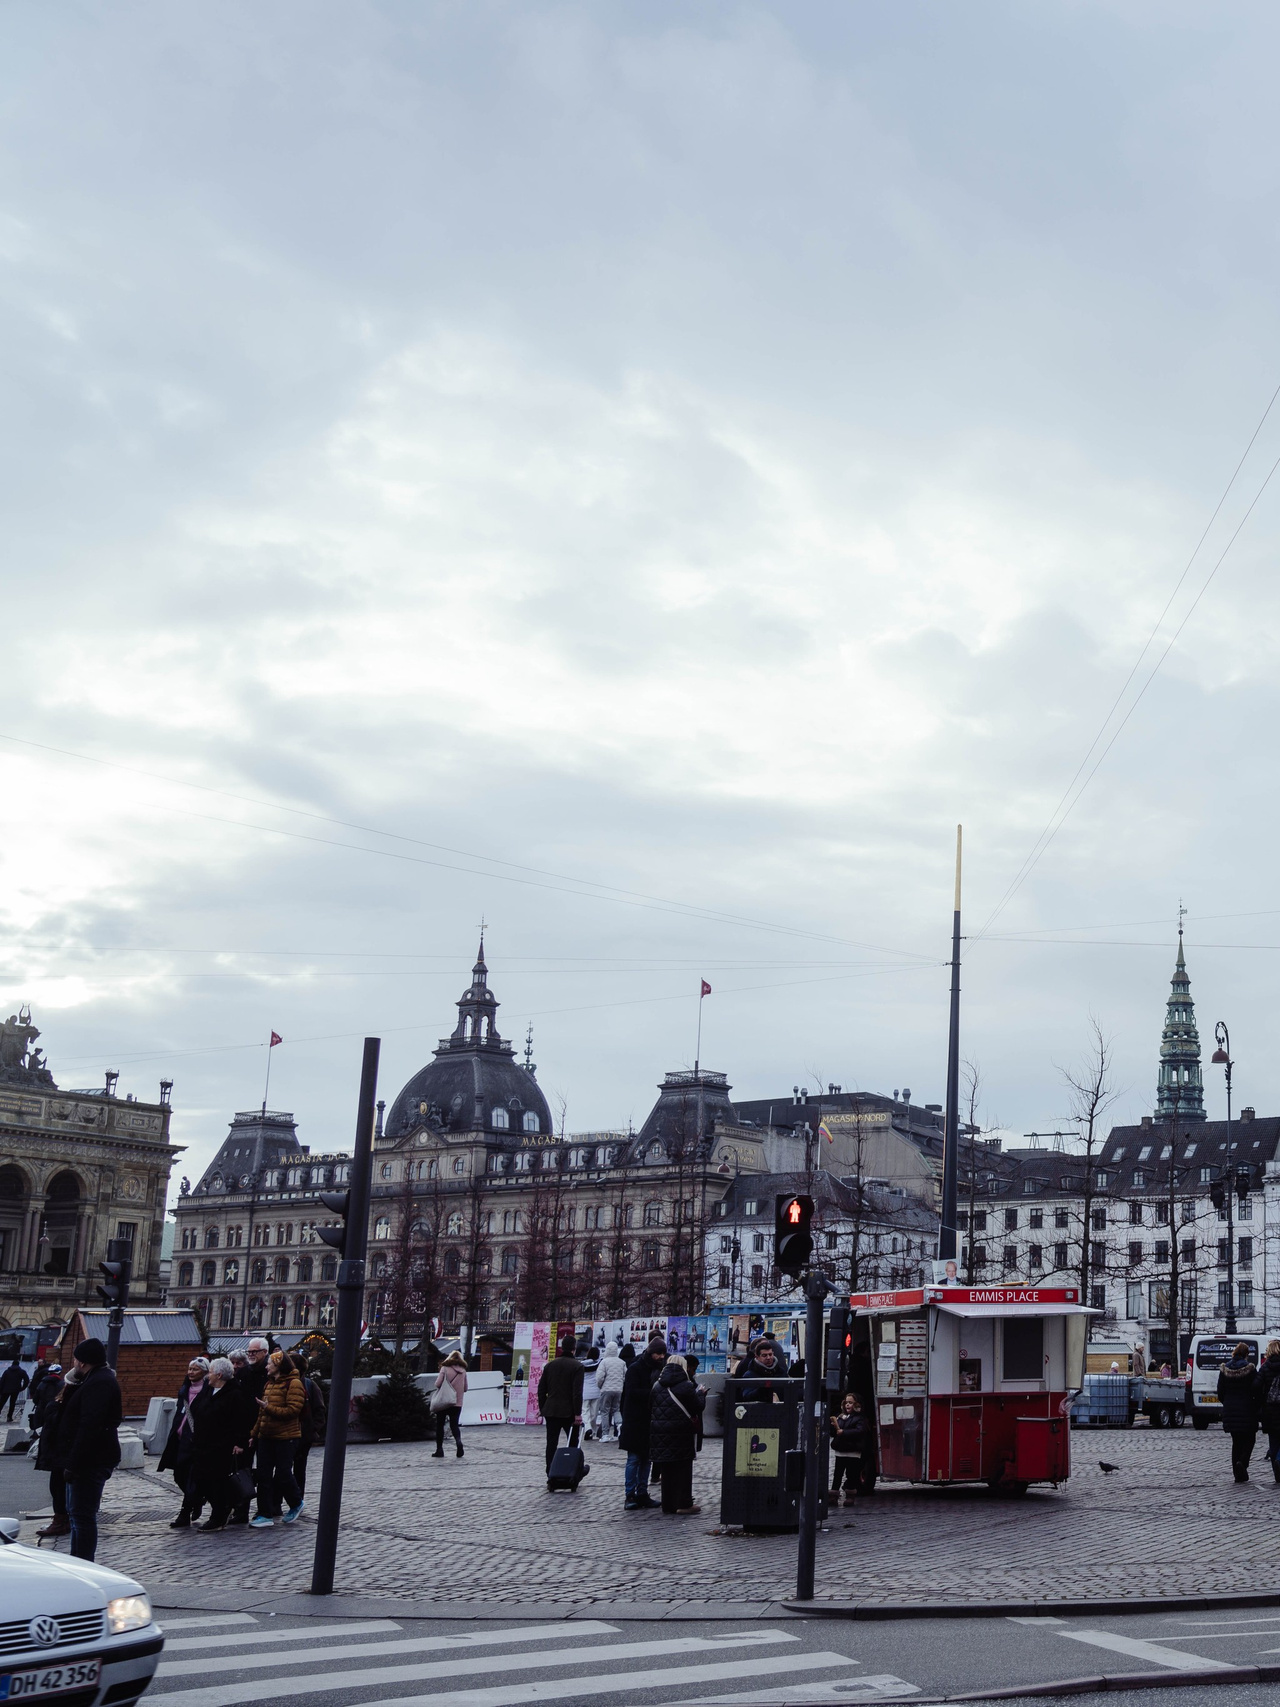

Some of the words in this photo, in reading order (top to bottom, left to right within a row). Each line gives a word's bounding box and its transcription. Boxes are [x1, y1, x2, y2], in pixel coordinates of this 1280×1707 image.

[822, 1114, 857, 1124] MAGASIN
[864, 1113, 887, 1122] NORD
[521, 1135, 571, 1146] MAGASI
[279, 1154, 322, 1165] MAGASIN
[882, 1294, 894, 1305] PLACE
[969, 1290, 1004, 1302] EMMIS
[1006, 1290, 1039, 1302] PLACE
[480, 1413, 503, 1422] HTU
[9, 1674, 38, 1696] DH
[40, 1670, 63, 1690] 42
[65, 1663, 98, 1686] 356
